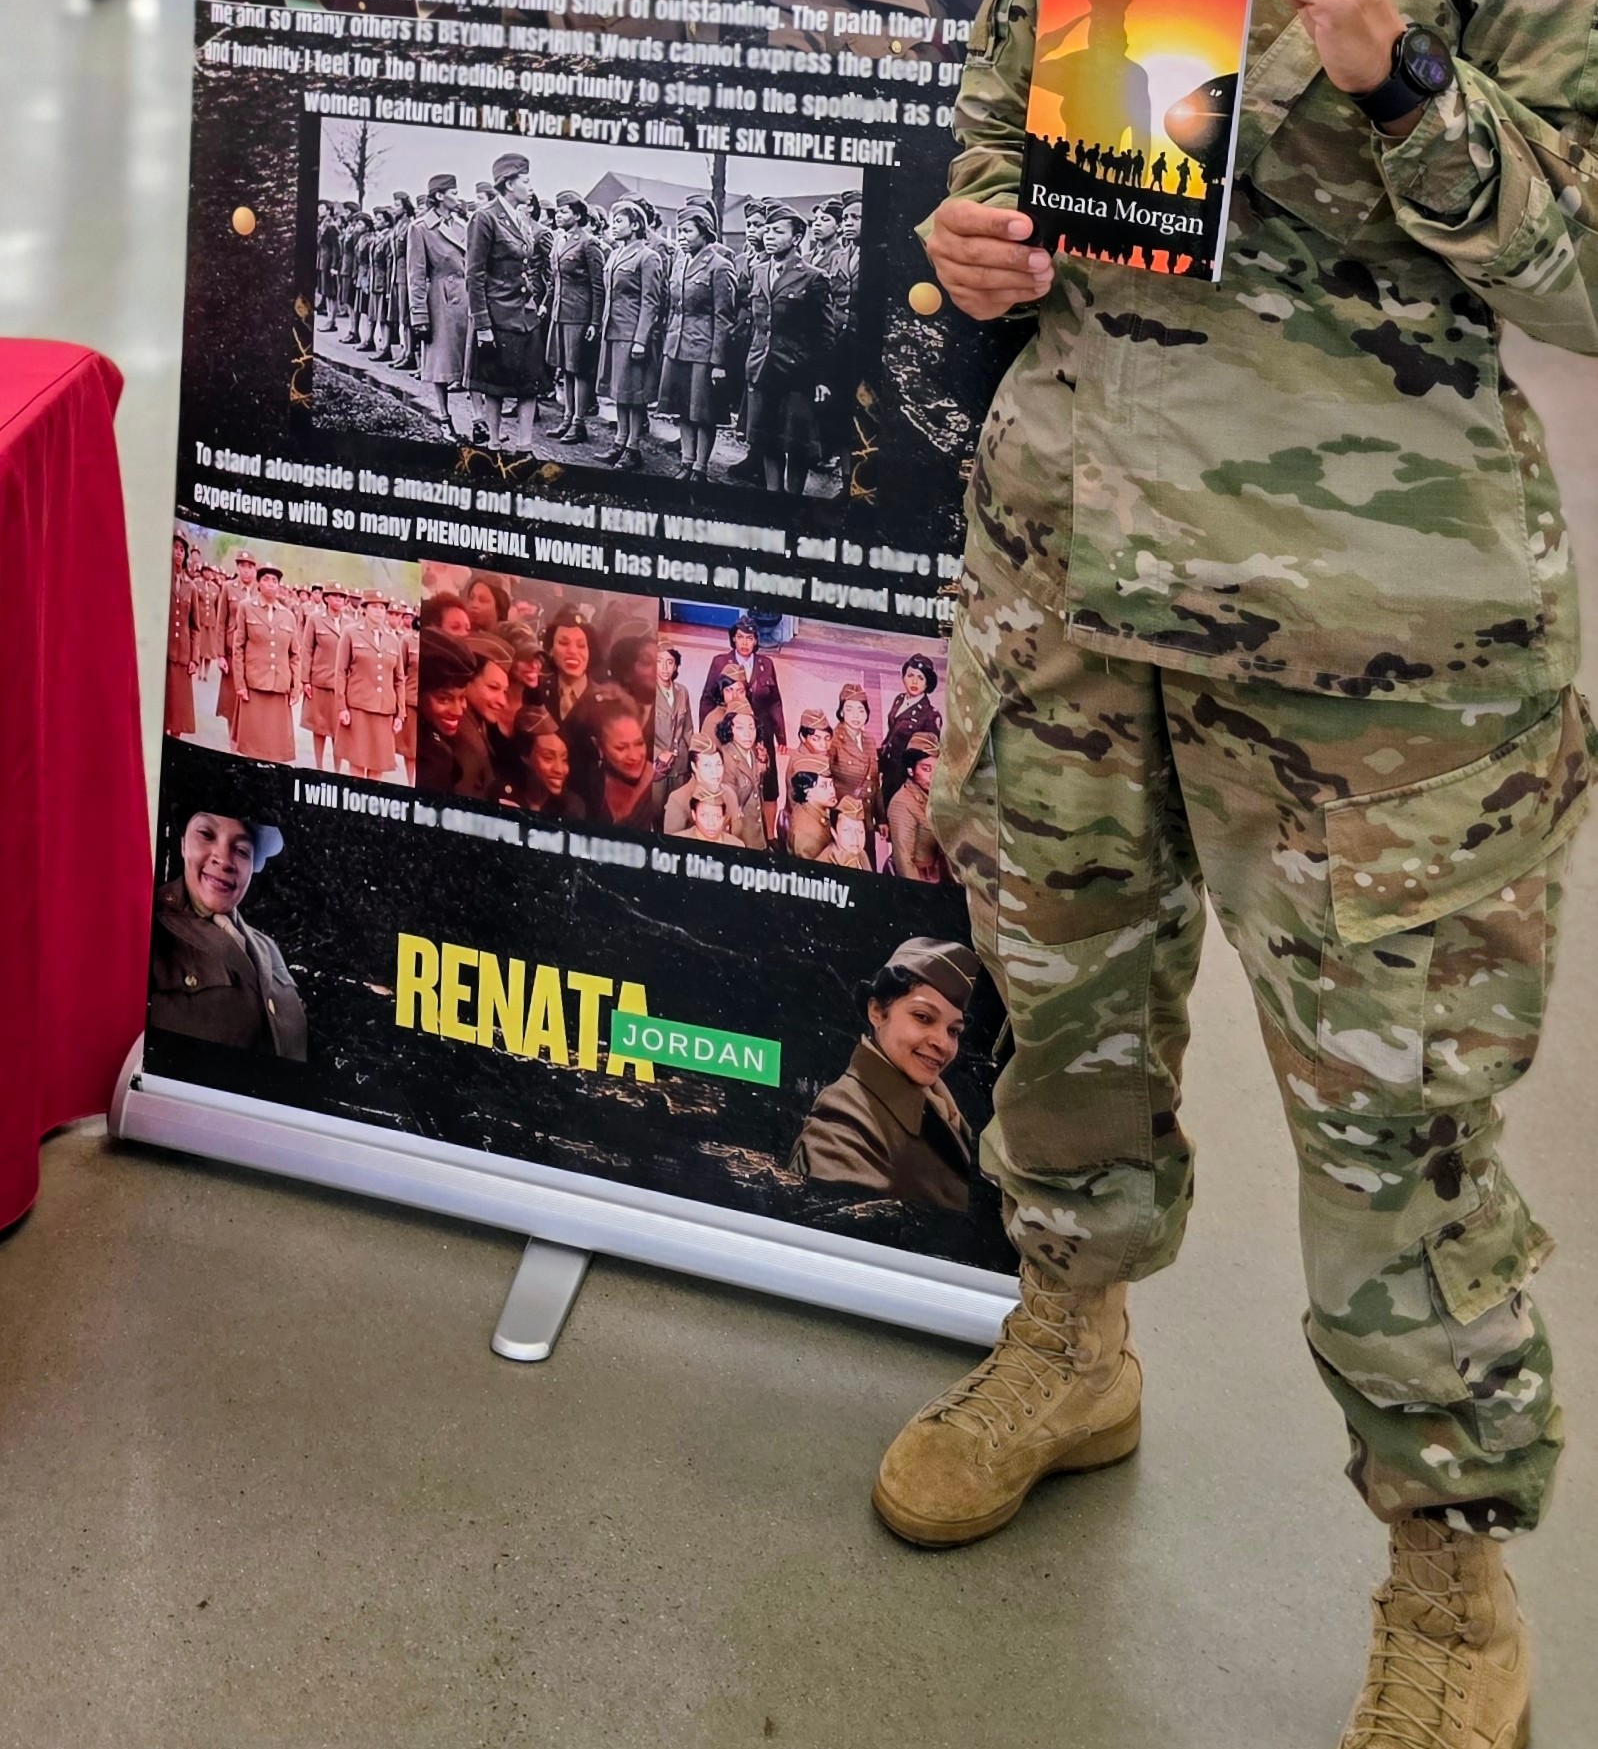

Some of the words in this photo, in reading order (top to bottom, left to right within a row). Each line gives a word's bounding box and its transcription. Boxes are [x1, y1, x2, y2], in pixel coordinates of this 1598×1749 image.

[211, 1, 232, 23] me
[236, 5, 265, 29] and
[270, 10, 292, 31] so
[296, 10, 345, 38] many
[351, 16, 411, 40] others
[416, 20, 433, 42] is
[439, 21, 504, 48] BEYOND
[670, 40, 741, 68] cannot
[747, 46, 831, 75] express
[837, 51, 872, 77] the
[791, 5, 828, 32] The
[834, 9, 881, 36] path
[888, 13, 936, 42] they
[205, 40, 230, 63] and
[232, 41, 299, 71] humility
[314, 50, 349, 76] feel
[354, 54, 380, 78] for
[385, 56, 415, 81] the
[420, 59, 515, 90] incredible
[520, 70, 633, 105] opportunity
[639, 77, 658, 103] to
[716, 84, 756, 110] into
[762, 89, 797, 114] the
[903, 102, 930, 126] as
[304, 91, 370, 116] women
[376, 95, 454, 126] featured
[459, 101, 477, 127] in
[482, 103, 513, 131] Mr.
[518, 108, 565, 136] Tyler
[571, 116, 639, 144] Perry's
[645, 120, 690, 150] film,
[697, 125, 730, 151] THE
[735, 128, 765, 154] SIX
[772, 131, 835, 160] TRIPLE
[841, 137, 901, 167] EIGHT.
[1031, 184, 1107, 218] Renata
[1114, 198, 1204, 235] Morgan
[196, 441, 212, 466] To
[215, 448, 261, 477] stand
[265, 457, 354, 491] alongside
[358, 470, 389, 496] the
[394, 475, 471, 511] amazing
[476, 488, 511, 518] and
[194, 482, 283, 520] experience
[288, 500, 328, 528] with
[332, 508, 354, 530] so
[360, 512, 411, 541] many
[416, 517, 529, 560] PHENOMENAL
[535, 536, 610, 575] WOMEN,
[614, 549, 651, 576] has
[294, 779, 299, 802] I
[305, 783, 338, 809] will
[343, 787, 409, 821] forever
[730, 864, 855, 908] opportunity.
[396, 933, 656, 1083] RENATA
[623, 1024, 765, 1072] JORDAN
